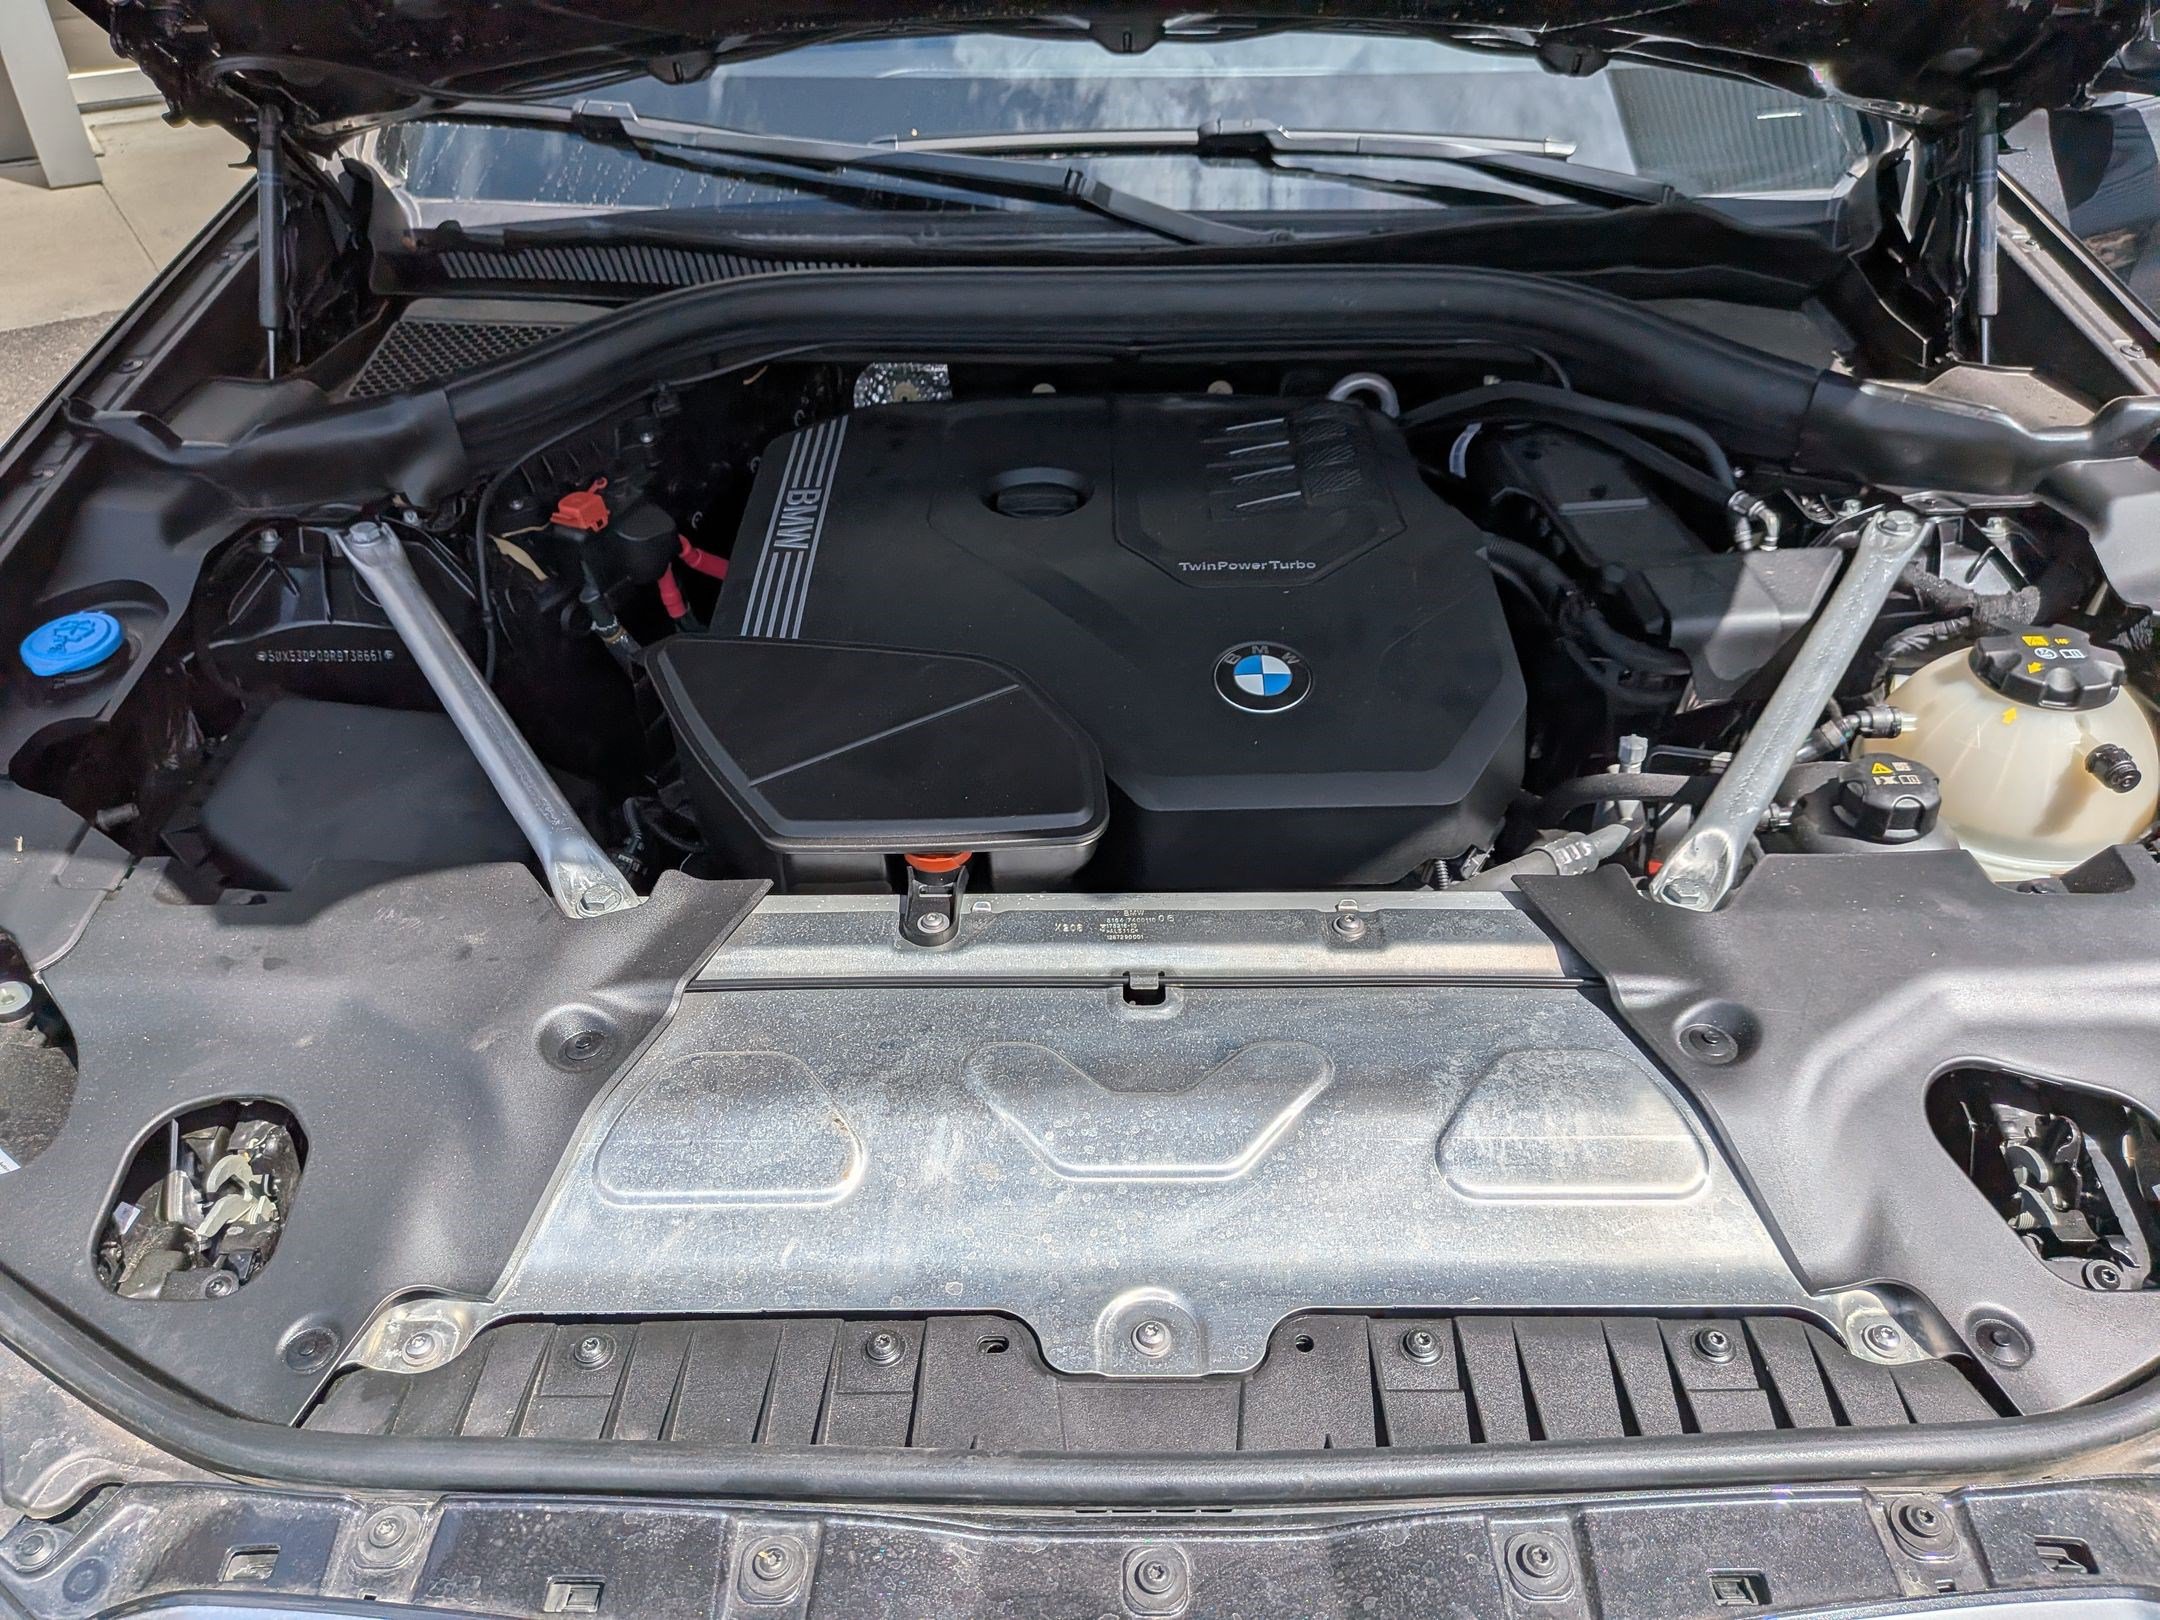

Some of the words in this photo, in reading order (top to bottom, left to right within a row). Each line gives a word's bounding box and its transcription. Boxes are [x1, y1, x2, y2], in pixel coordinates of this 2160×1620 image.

[773, 488, 822, 549] BMW
[1268, 560, 1317, 569] Turbo
[1224, 645, 1300, 665] BMW
[1123, 909, 1145, 917] BMW
